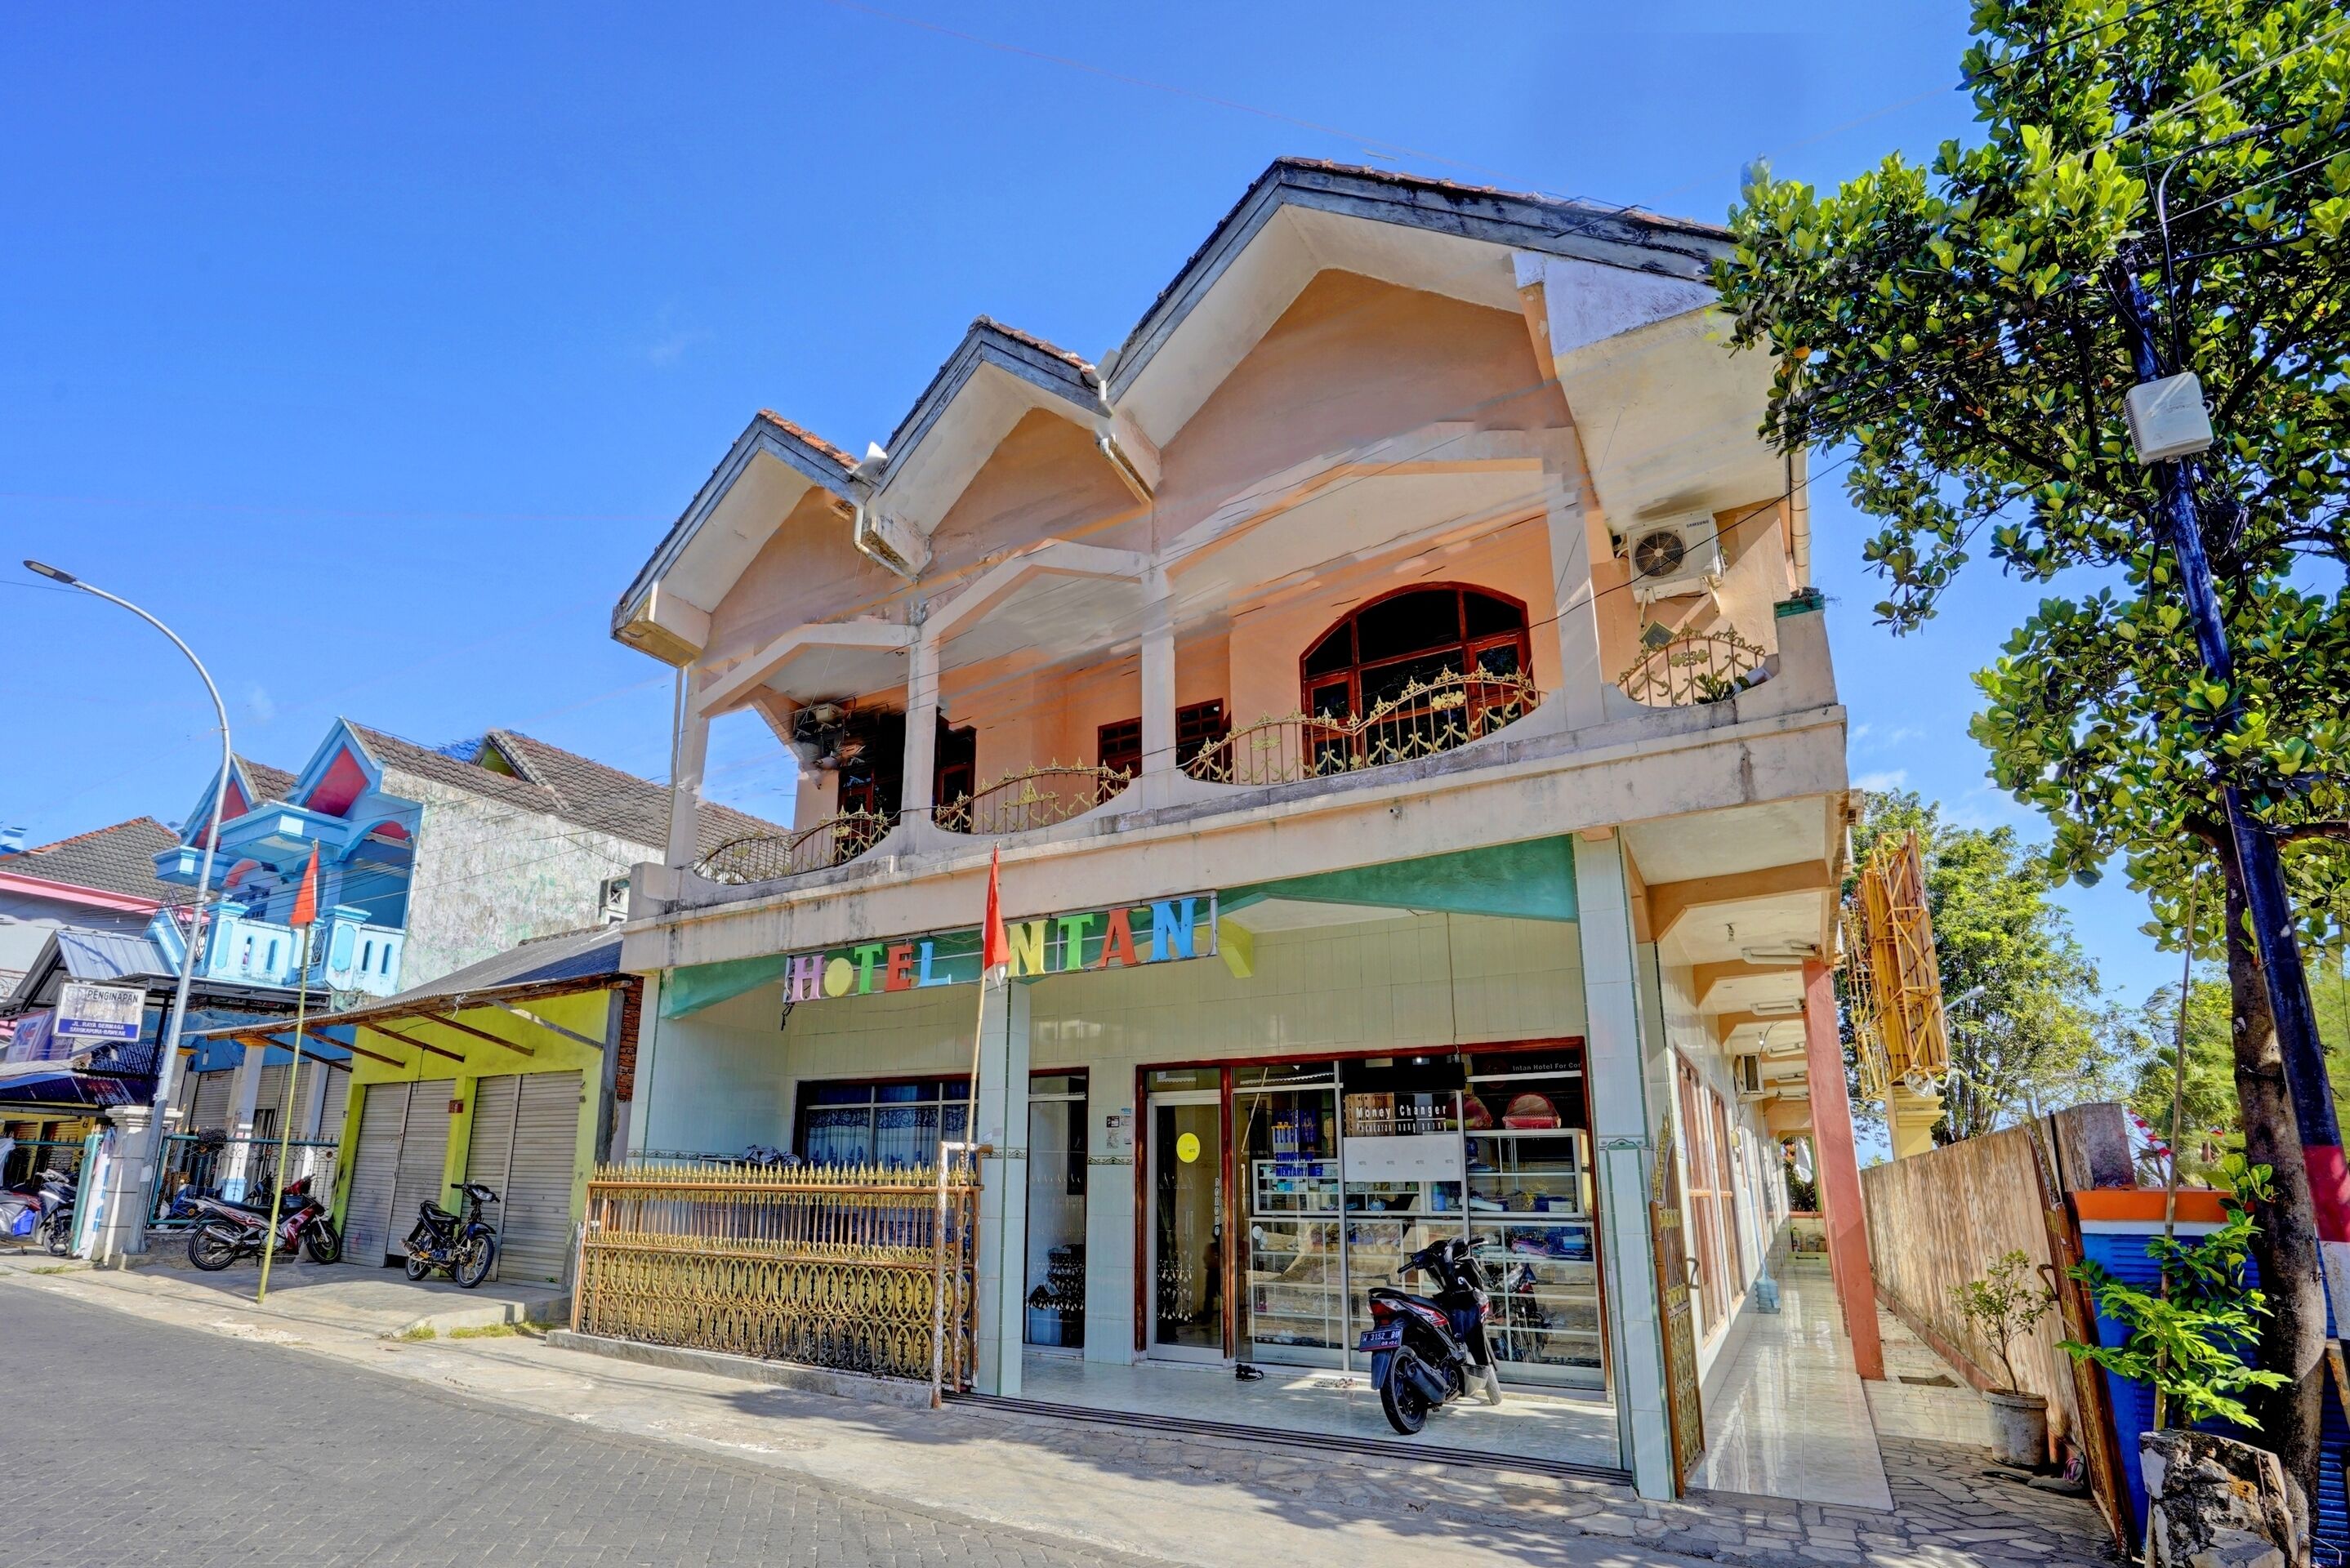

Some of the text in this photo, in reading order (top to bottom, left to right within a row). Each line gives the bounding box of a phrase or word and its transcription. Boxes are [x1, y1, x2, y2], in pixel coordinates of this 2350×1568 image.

[789, 897, 1197, 1003] HOTEL NTAN
[87, 990, 139, 1003] PENGINAPAN
[1356, 1104, 1447, 1120] Money Changer
[1370, 1332, 1386, 1341] 3152
